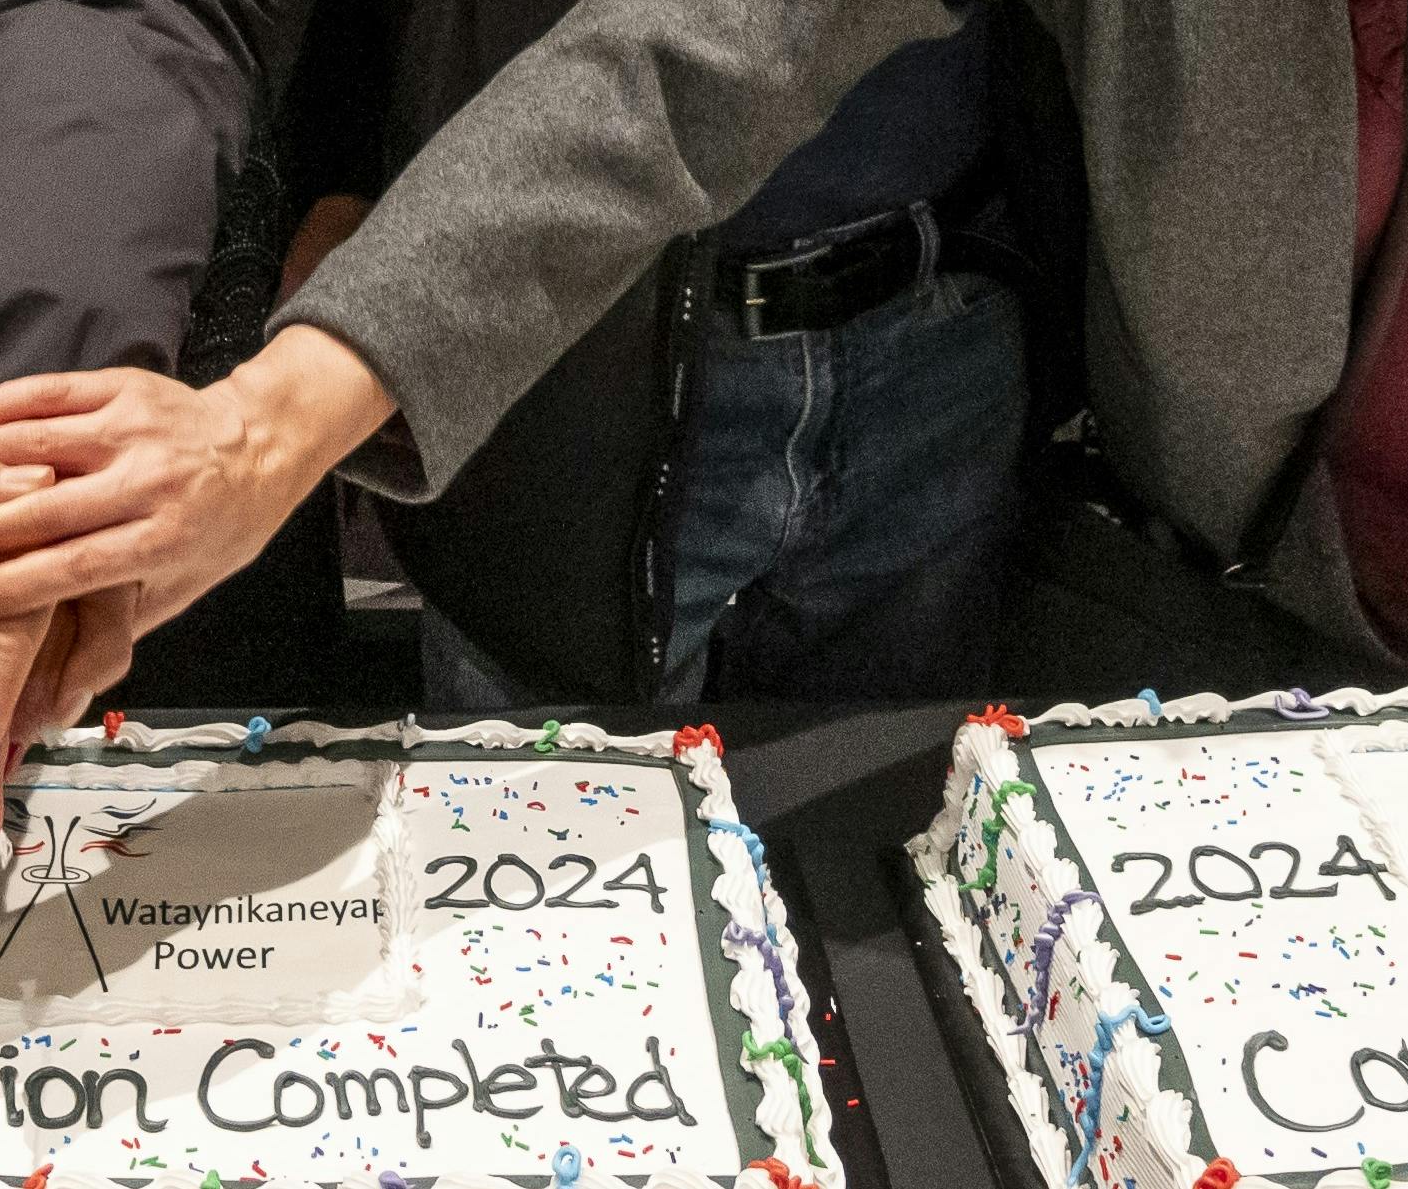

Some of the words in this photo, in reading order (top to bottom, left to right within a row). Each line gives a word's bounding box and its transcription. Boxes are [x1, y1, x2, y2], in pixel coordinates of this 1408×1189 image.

[424, 853, 668, 914] 2024
[1111, 834, 1396, 914] 2024
[154, 941, 275, 970] Power
[197, 1036, 698, 1149] Completed
